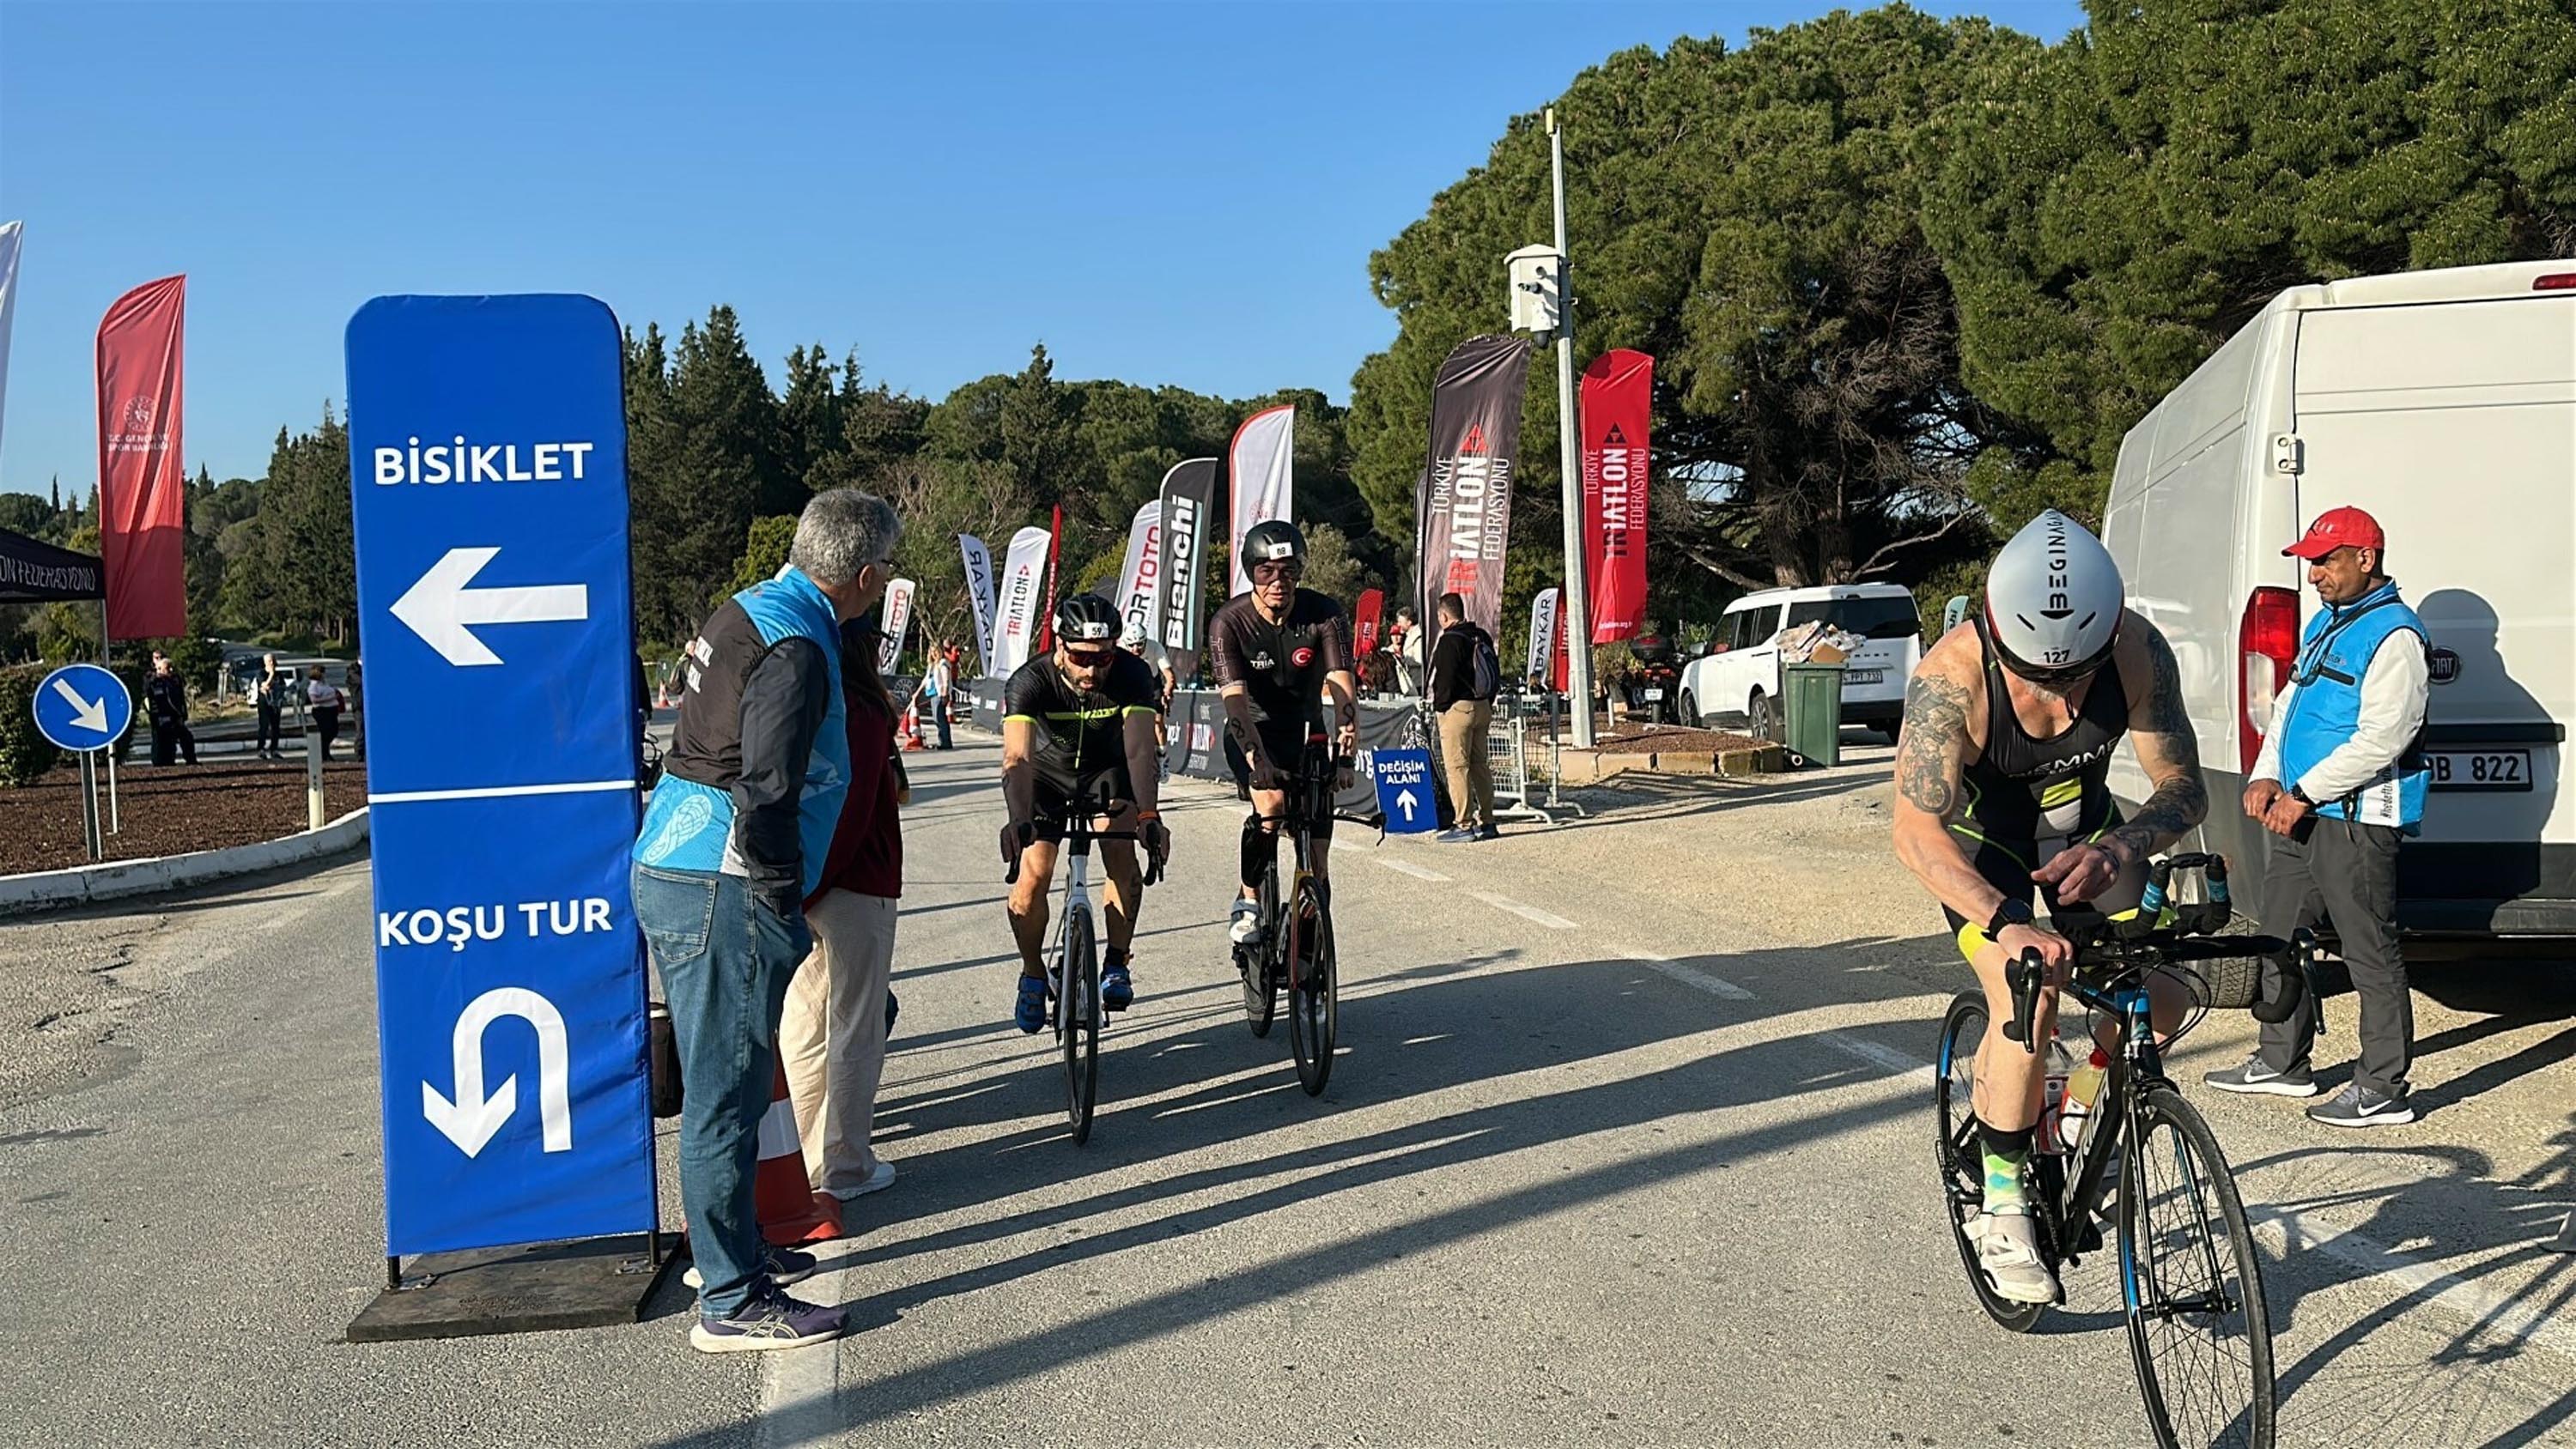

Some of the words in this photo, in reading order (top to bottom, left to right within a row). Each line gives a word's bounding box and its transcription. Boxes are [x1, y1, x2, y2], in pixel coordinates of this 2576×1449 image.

[374, 435, 592, 485] BİSİKLET
[1431, 456, 1454, 515] TÜRKİYE
[1483, 458, 1510, 561] FEDERASYONU
[1602, 448, 1628, 557] TRİATLON
[1630, 448, 1646, 530] FEDERASYONU
[1166, 494, 1194, 649] Bianchi
[1091, 627, 1103, 636] 59
[1534, 598, 1551, 668] BAYKAR
[2043, 649, 2070, 664] 127
[1250, 658, 1275, 670] TRIA
[1378, 759, 1425, 778] DEĞİŞİM
[1386, 773, 1421, 785] ALANI
[2471, 756, 2520, 781] 822
[380, 905, 505, 952] KOŞU
[519, 898, 612, 937] TUR
